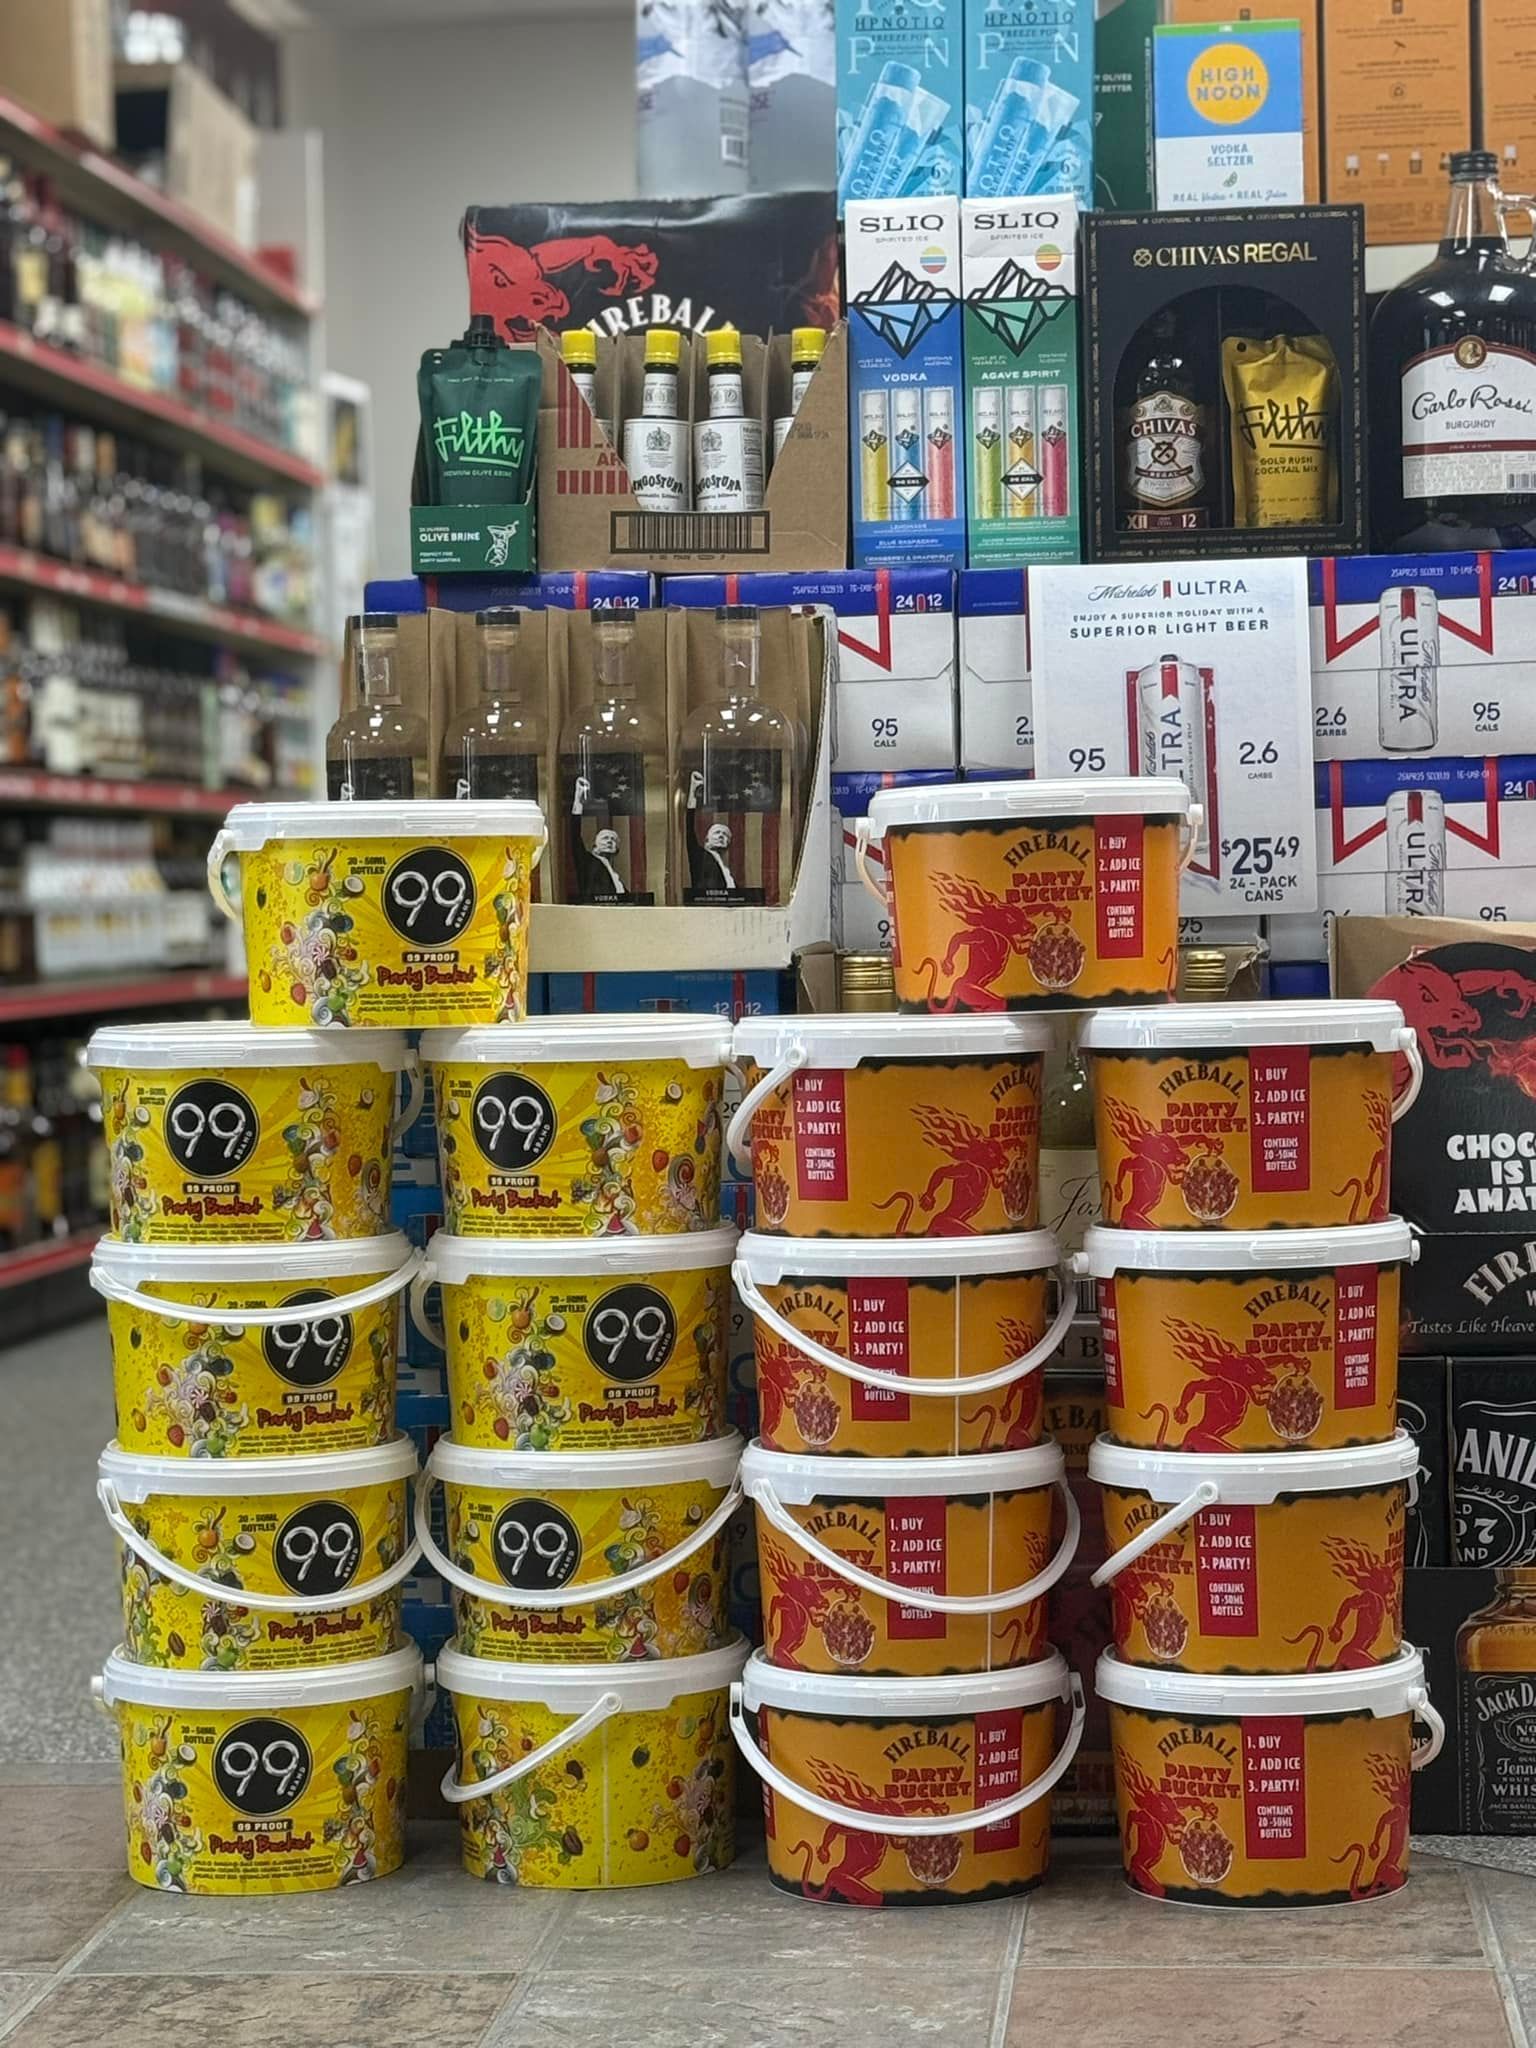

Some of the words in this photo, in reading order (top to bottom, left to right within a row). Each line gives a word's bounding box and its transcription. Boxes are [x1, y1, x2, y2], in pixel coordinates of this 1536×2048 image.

[855, 16, 944, 30] HPNOTIQ
[985, 12, 1074, 27] HPNOTIQ
[1201, 66, 1254, 82] HIGH
[1197, 85, 1261, 101] NOON
[1211, 144, 1248, 155] VODKA
[1207, 155, 1254, 167] SELTZER
[859, 213, 945, 233] SLIQ
[974, 211, 1061, 230] SLIQ
[1156, 245, 1240, 266] CHIVAS
[1244, 242, 1317, 262] REGAL
[882, 373, 927, 383] VODKA
[981, 370, 1020, 380] AGAVE
[1023, 369, 1061, 379] SPIRIT
[1412, 391, 1468, 420] Carlo
[1130, 419, 1197, 438] CHIVAS
[1445, 418, 1496, 431] BURGUNDY
[1260, 456, 1286, 465] GOLD
[1289, 456, 1312, 464] RUSH
[1255, 466, 1301, 475] COCKTAIL
[1182, 514, 1197, 528] 12
[419, 532, 449, 542] OLIVE
[450, 531, 481, 542] BRINE
[1178, 580, 1247, 597] ULTRA
[1498, 577, 1517, 590] 24
[623, 597, 639, 609] 12
[896, 595, 913, 608] 24
[927, 594, 943, 606] 12
[1073, 613, 1107, 623] ENJOY
[1110, 612, 1117, 621] A
[1121, 611, 1173, 620] SUPERIOR
[1177, 609, 1222, 618] HOLIDAY
[1227, 607, 1251, 616] WITH
[1257, 606, 1264, 614] A
[1070, 624, 1158, 639] SUPERIOR
[1166, 621, 1217, 635] LIGHT
[1225, 620, 1269, 632] BEER
[1399, 628, 1418, 722] ULTRA
[1315, 706, 1347, 727] 2.6
[1473, 702, 1500, 721] 95
[872, 718, 899, 736] 95
[1315, 728, 1347, 737] CARBS
[1475, 724, 1499, 732] CALS
[874, 740, 897, 748] CALS
[1068, 747, 1106, 772] 95
[1239, 741, 1279, 765] 2.6
[1504, 781, 1524, 795] 24
[1003, 833, 1092, 869] FIREBALL
[1012, 870, 1085, 887] PARTY
[1230, 878, 1246, 890] 24
[1260, 875, 1298, 888] PACK
[391, 870, 466, 928] 99
[1245, 890, 1283, 902] CANS
[1480, 906, 1507, 921] 95
[877, 920, 890, 938] 9
[422, 952, 455, 962] PROOF
[377, 965, 422, 991] Party
[425, 963, 477, 985] Bucket
[713, 1002, 729, 1015] 12
[1158, 1063, 1241, 1099] FIREBALL
[1266, 1069, 1287, 1081] BUY
[1267, 1090, 1288, 1102] ADD
[1290, 1089, 1306, 1102] ICE
[1167, 1103, 1238, 1118] PARTY
[1267, 1111, 1305, 1125] PARTY!
[171, 1103, 246, 1159] 99
[477, 1095, 544, 1151] 99
[1263, 1137, 1299, 1148] CONTAINS
[1266, 1160, 1297, 1171] BOTTLES
[1491, 1160, 1523, 1185] IS
[504, 1177, 536, 1187] PROOF
[161, 1196, 203, 1221] Party
[204, 1196, 264, 1217] Bucket
[471, 1188, 506, 1215] Party
[507, 1189, 562, 1209] Bucket
[1243, 1283, 1328, 1318] FIREBALL
[1252, 1321, 1326, 1336] PARTY
[1408, 1319, 1453, 1334] Tastes
[1456, 1319, 1488, 1334] Like
[271, 1317, 343, 1368] 99
[592, 1307, 666, 1364] 99
[257, 1407, 302, 1432] Party
[303, 1402, 354, 1425] Bucket
[579, 1402, 625, 1426] Party
[627, 1397, 678, 1419] Bucket
[1474, 1518, 1499, 1545] 7
[283, 1522, 354, 1581] 99
[498, 1520, 567, 1577] 99
[268, 1620, 313, 1643] Party
[315, 1614, 363, 1636] Bucket
[491, 1612, 528, 1638] Party
[529, 1614, 586, 1636] Bucket
[1475, 1688, 1520, 1722] JACK
[882, 1728, 968, 1764] FIREBALL
[1156, 1728, 1234, 1765] FIREBALL
[1259, 1736, 1281, 1748] BUY
[221, 1740, 299, 1797] 99
[1260, 1758, 1282, 1770] ADD
[1284, 1757, 1301, 1770] ICE
[892, 1766, 965, 1782] PARTY
[1165, 1763, 1232, 1782] PARTY
[1261, 1779, 1300, 1792] PARTY!
[1257, 1805, 1294, 1816] CONTAINS
[1260, 1828, 1293, 1839] BOTTLES
[208, 1834, 255, 1860] Party
[256, 1832, 315, 1853] Bucket
